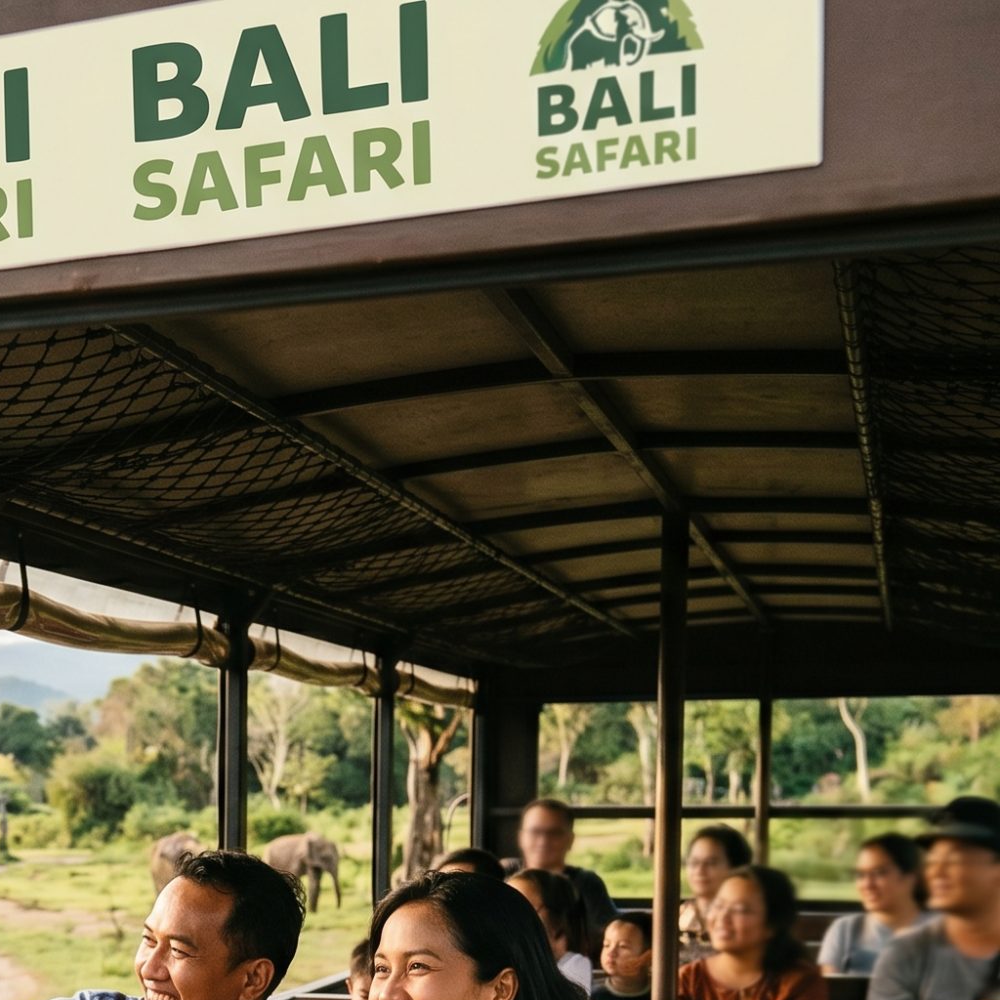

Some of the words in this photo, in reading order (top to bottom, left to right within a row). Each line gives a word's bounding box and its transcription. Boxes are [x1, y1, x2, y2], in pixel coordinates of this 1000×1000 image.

[131, 1, 429, 143] BALI
[537, 63, 697, 137] BALI
[132, 119, 432, 221] SAFARI
[535, 126, 697, 180] SAFARI
